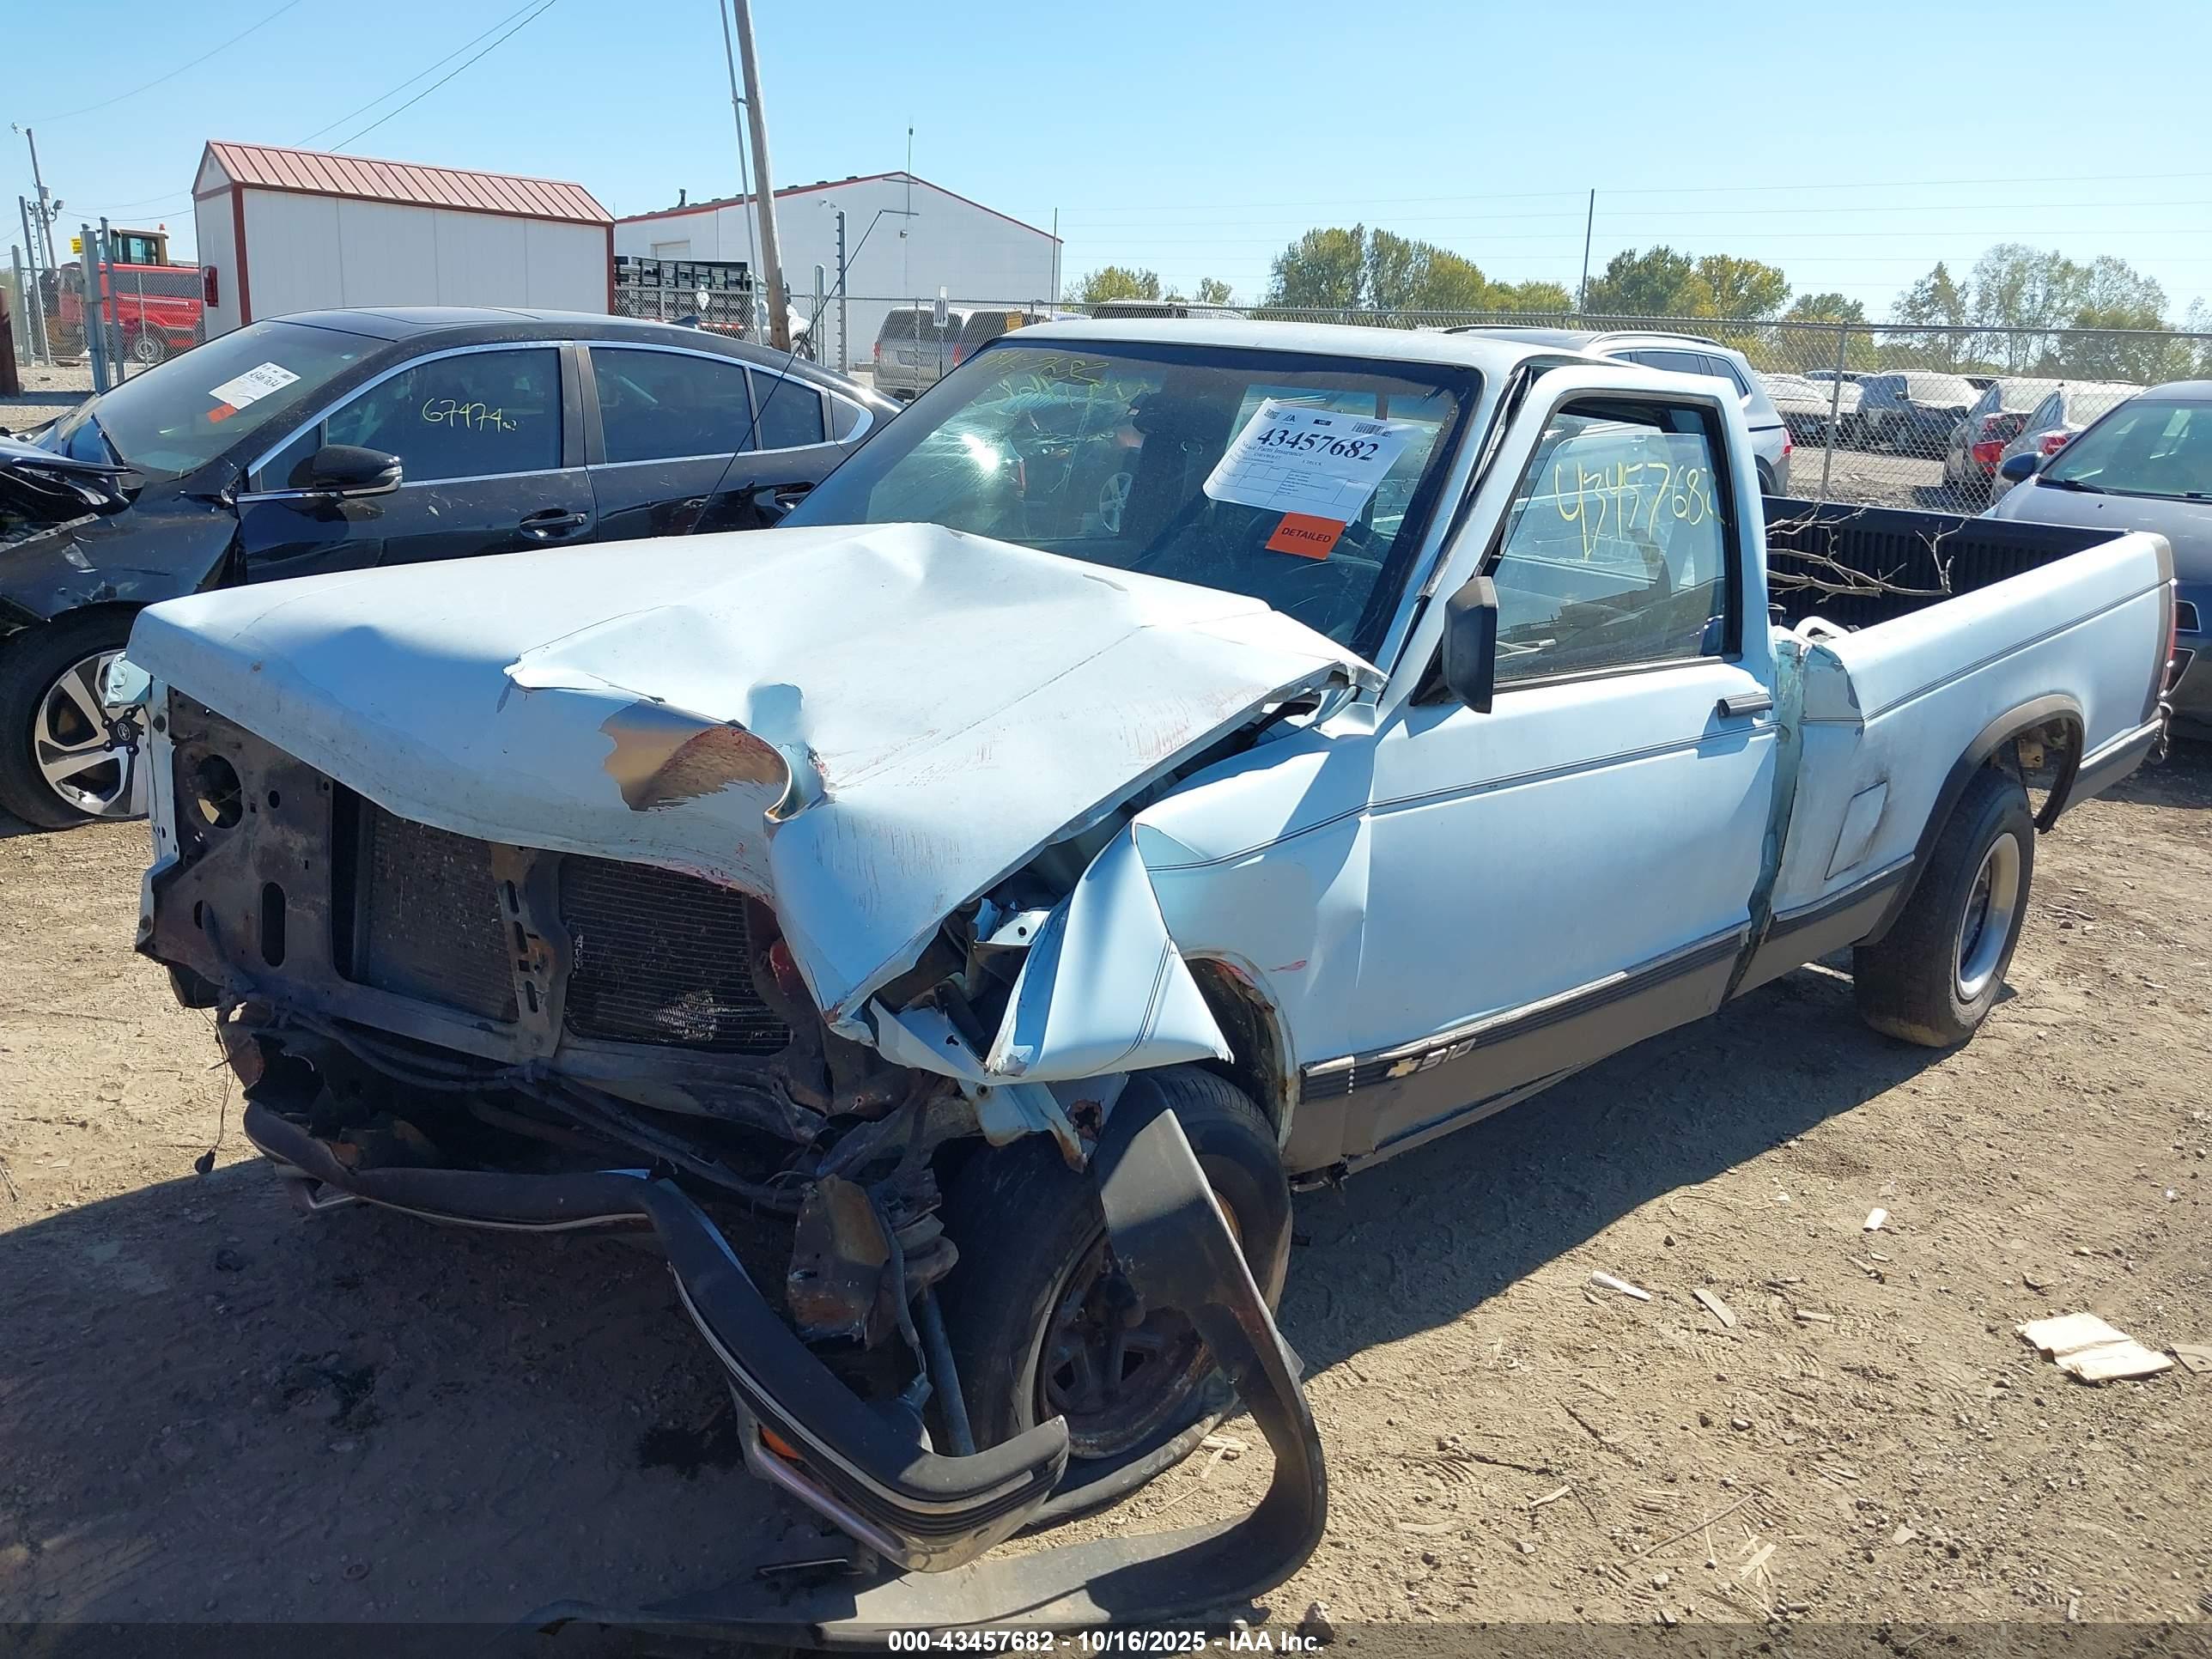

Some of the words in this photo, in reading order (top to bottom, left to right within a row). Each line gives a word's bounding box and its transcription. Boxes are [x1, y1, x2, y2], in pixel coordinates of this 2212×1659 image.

[1257, 428, 1379, 461] 43457682
[1273, 447, 1304, 458] Insurance
[1281, 527, 1332, 543] DETAILED
